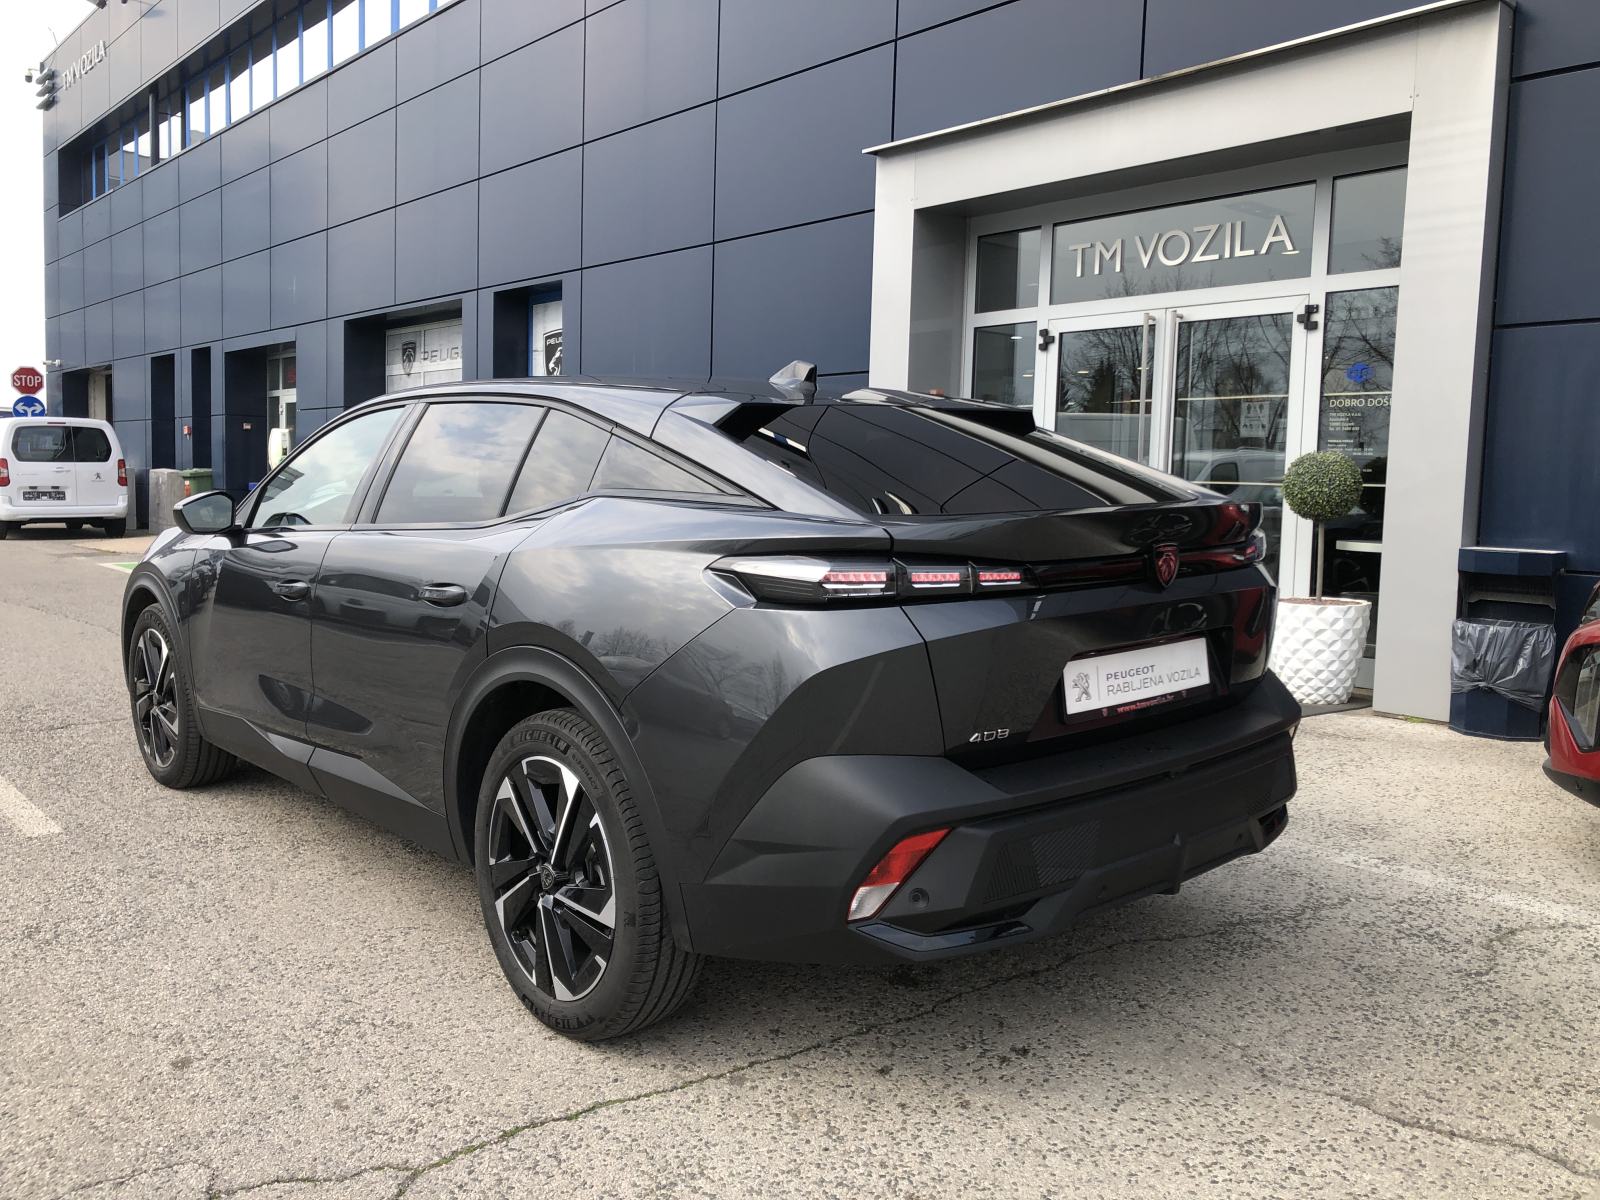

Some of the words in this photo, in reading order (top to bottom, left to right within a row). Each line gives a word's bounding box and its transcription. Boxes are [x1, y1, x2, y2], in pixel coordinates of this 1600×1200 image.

[62, 65, 75, 90] TM
[73, 40, 107, 79] VOZILA
[1069, 238, 1124, 278] TM
[1135, 214, 1300, 269] VOZILA
[420, 346, 462, 363] PEUG
[13, 374, 42, 388] STOP
[1329, 398, 1365, 408] DOBRO
[1105, 664, 1156, 682] PEUGEOT
[1106, 675, 1164, 696] RABLJENA
[1167, 666, 1201, 683] VOZILA
[512, 729, 571, 755] MICHELIN
[969, 728, 1010, 743] 408
